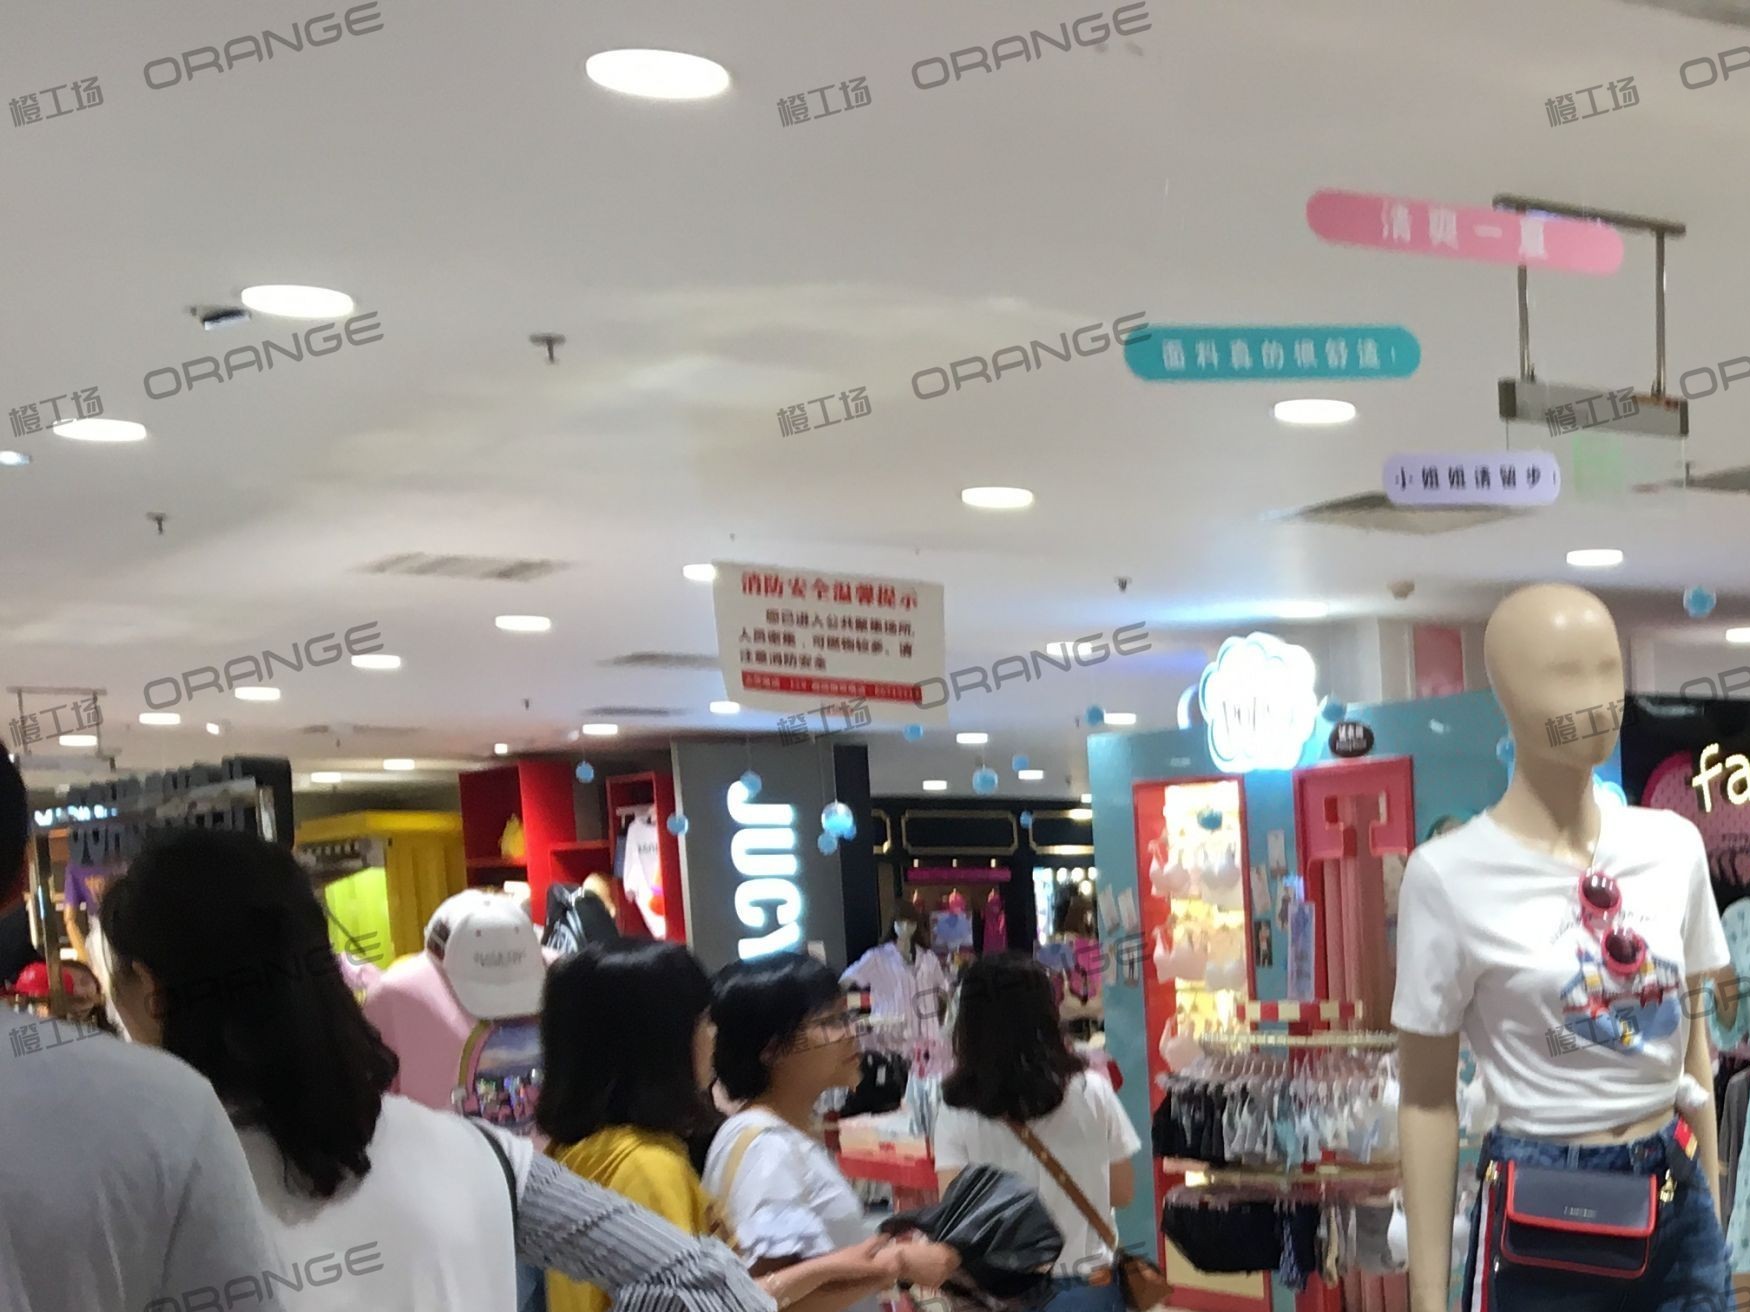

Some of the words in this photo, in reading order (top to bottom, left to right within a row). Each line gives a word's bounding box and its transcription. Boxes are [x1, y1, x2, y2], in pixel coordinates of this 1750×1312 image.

[741, 571, 918, 612] 消防安全温馨提示
